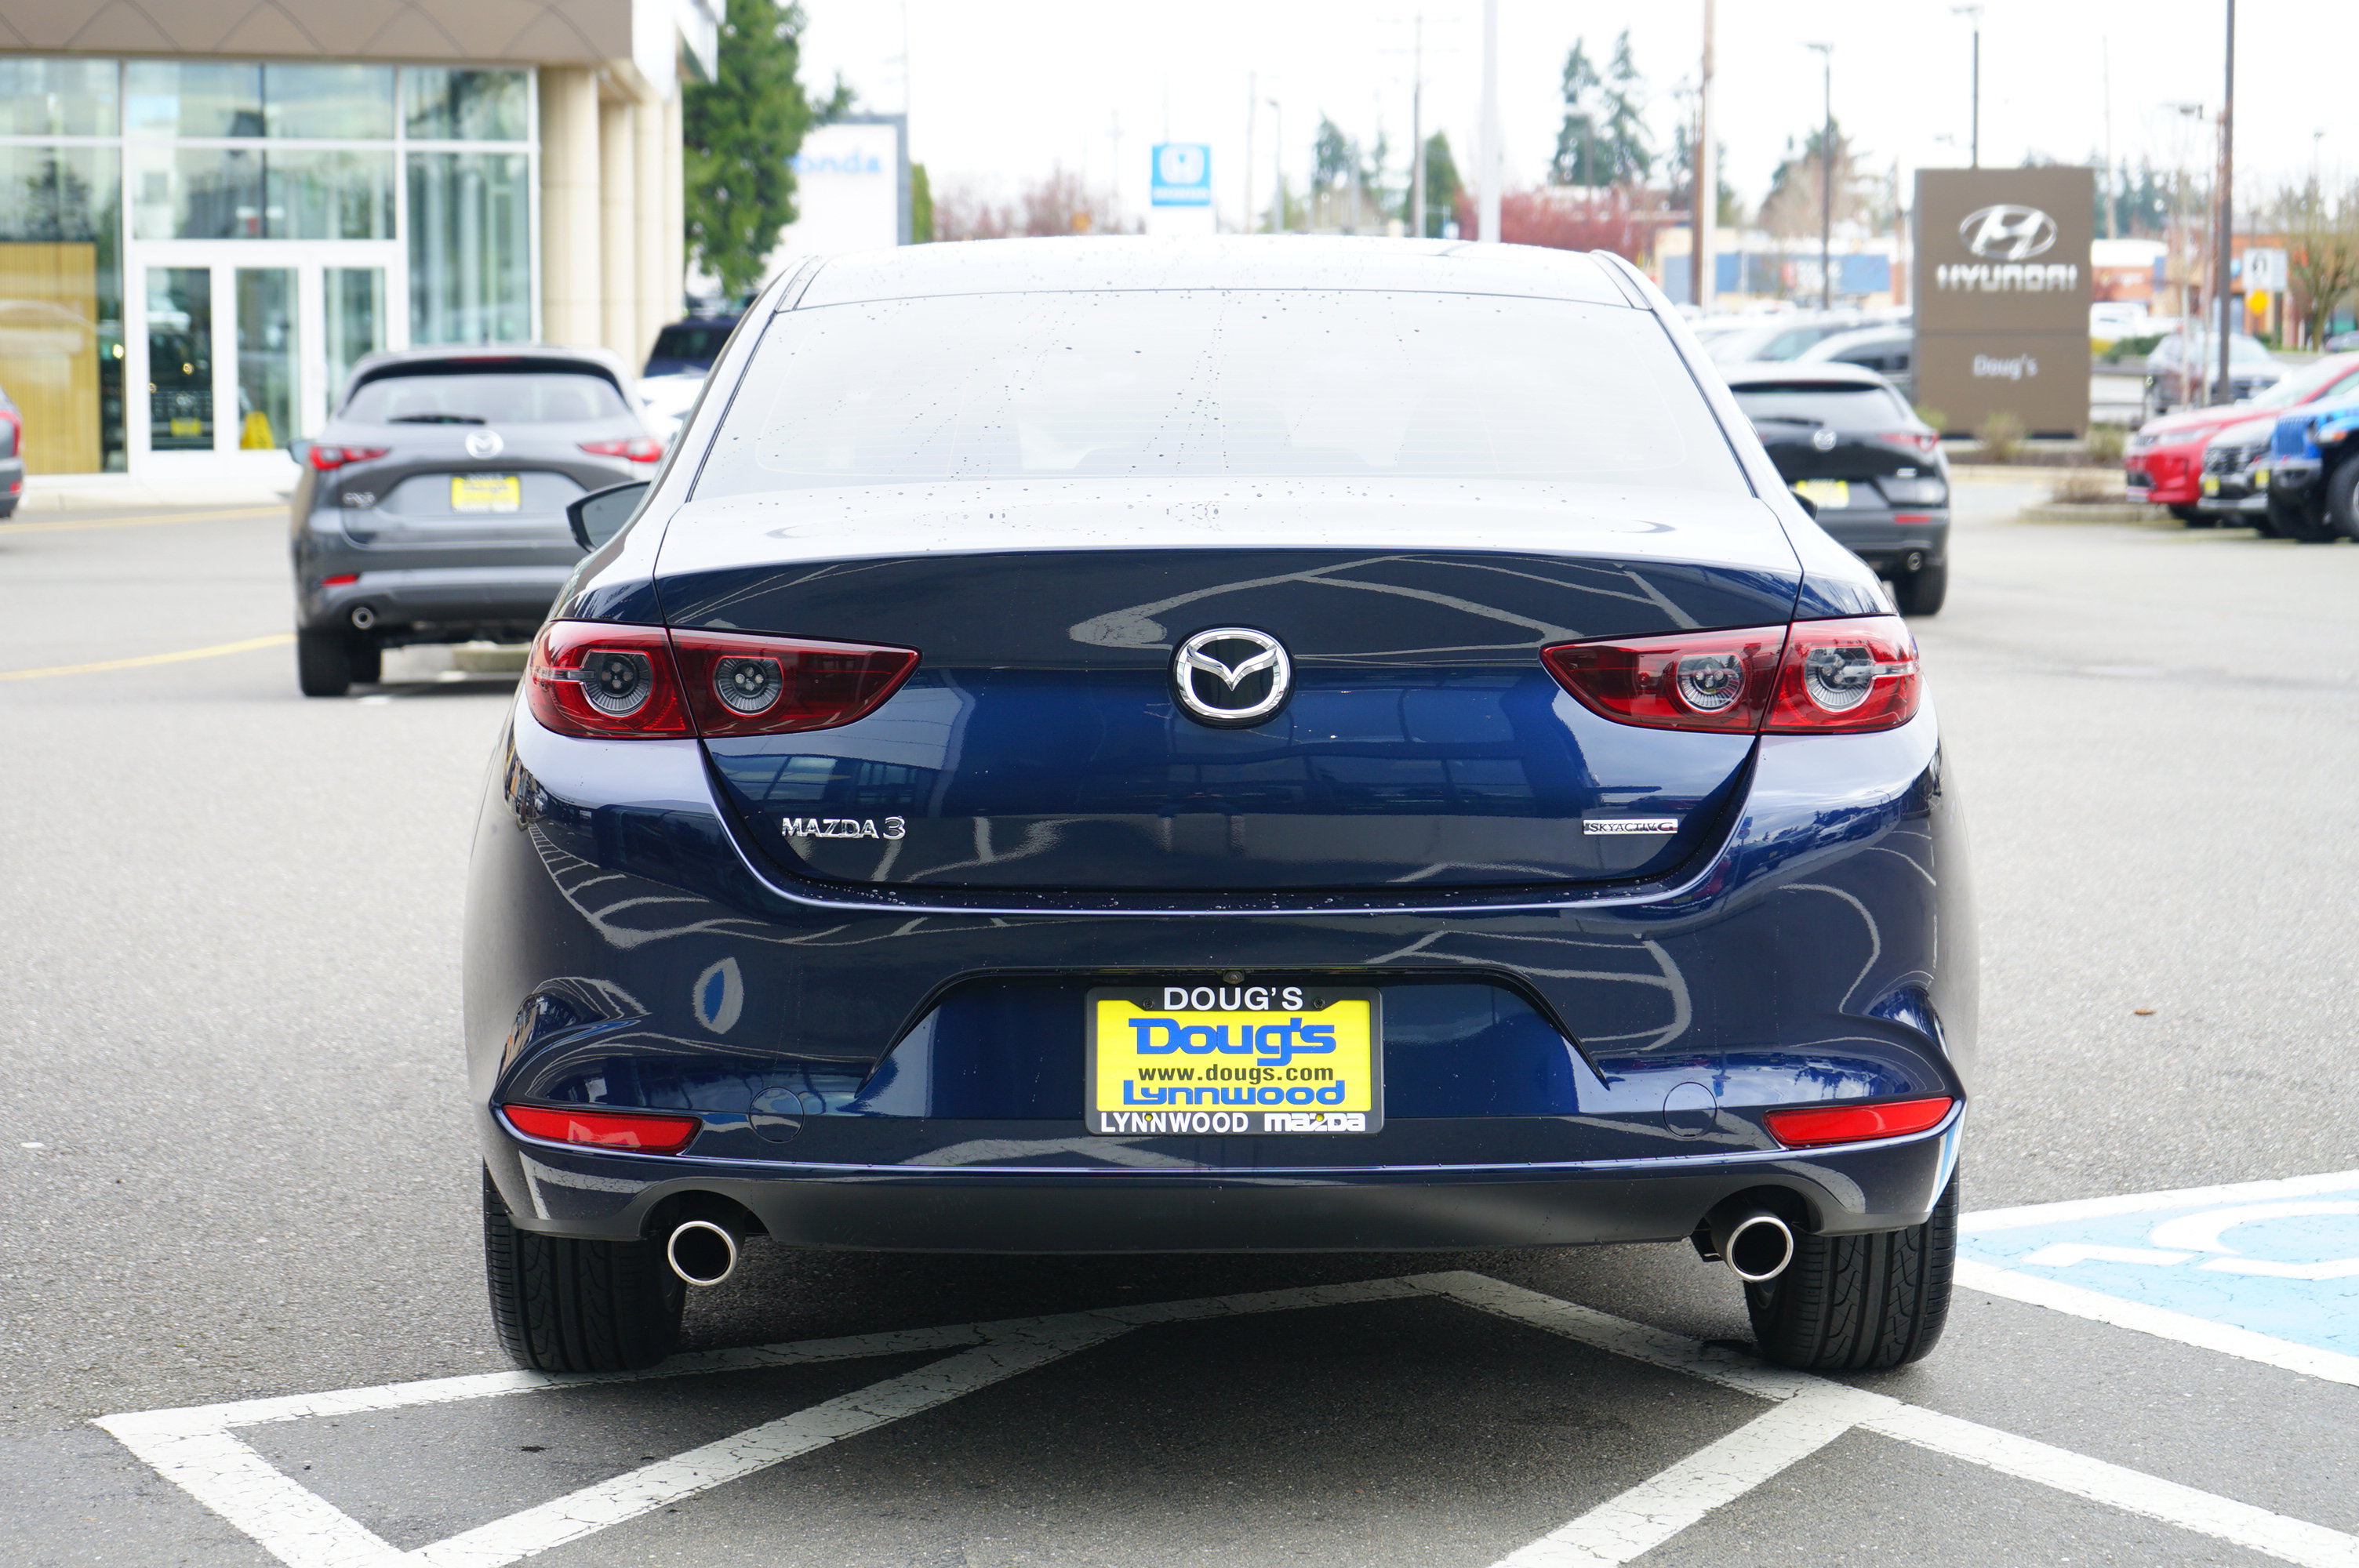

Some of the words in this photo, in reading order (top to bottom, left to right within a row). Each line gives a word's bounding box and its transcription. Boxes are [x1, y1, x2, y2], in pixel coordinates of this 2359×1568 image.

[789, 147, 881, 173] onda
[1937, 263, 2078, 291] HYUNDAI
[1972, 354, 2038, 379] Doug's
[782, 817, 880, 839] MAZDA
[883, 815, 906, 840] 3
[1164, 986, 1303, 1011] DOUG'S
[1128, 1017, 1336, 1066] Doug's
[1138, 1064, 1334, 1084] www.dougs.com
[1123, 1080, 1346, 1105] Lynnwood
[1100, 1112, 1249, 1133] LYNNWOOD
